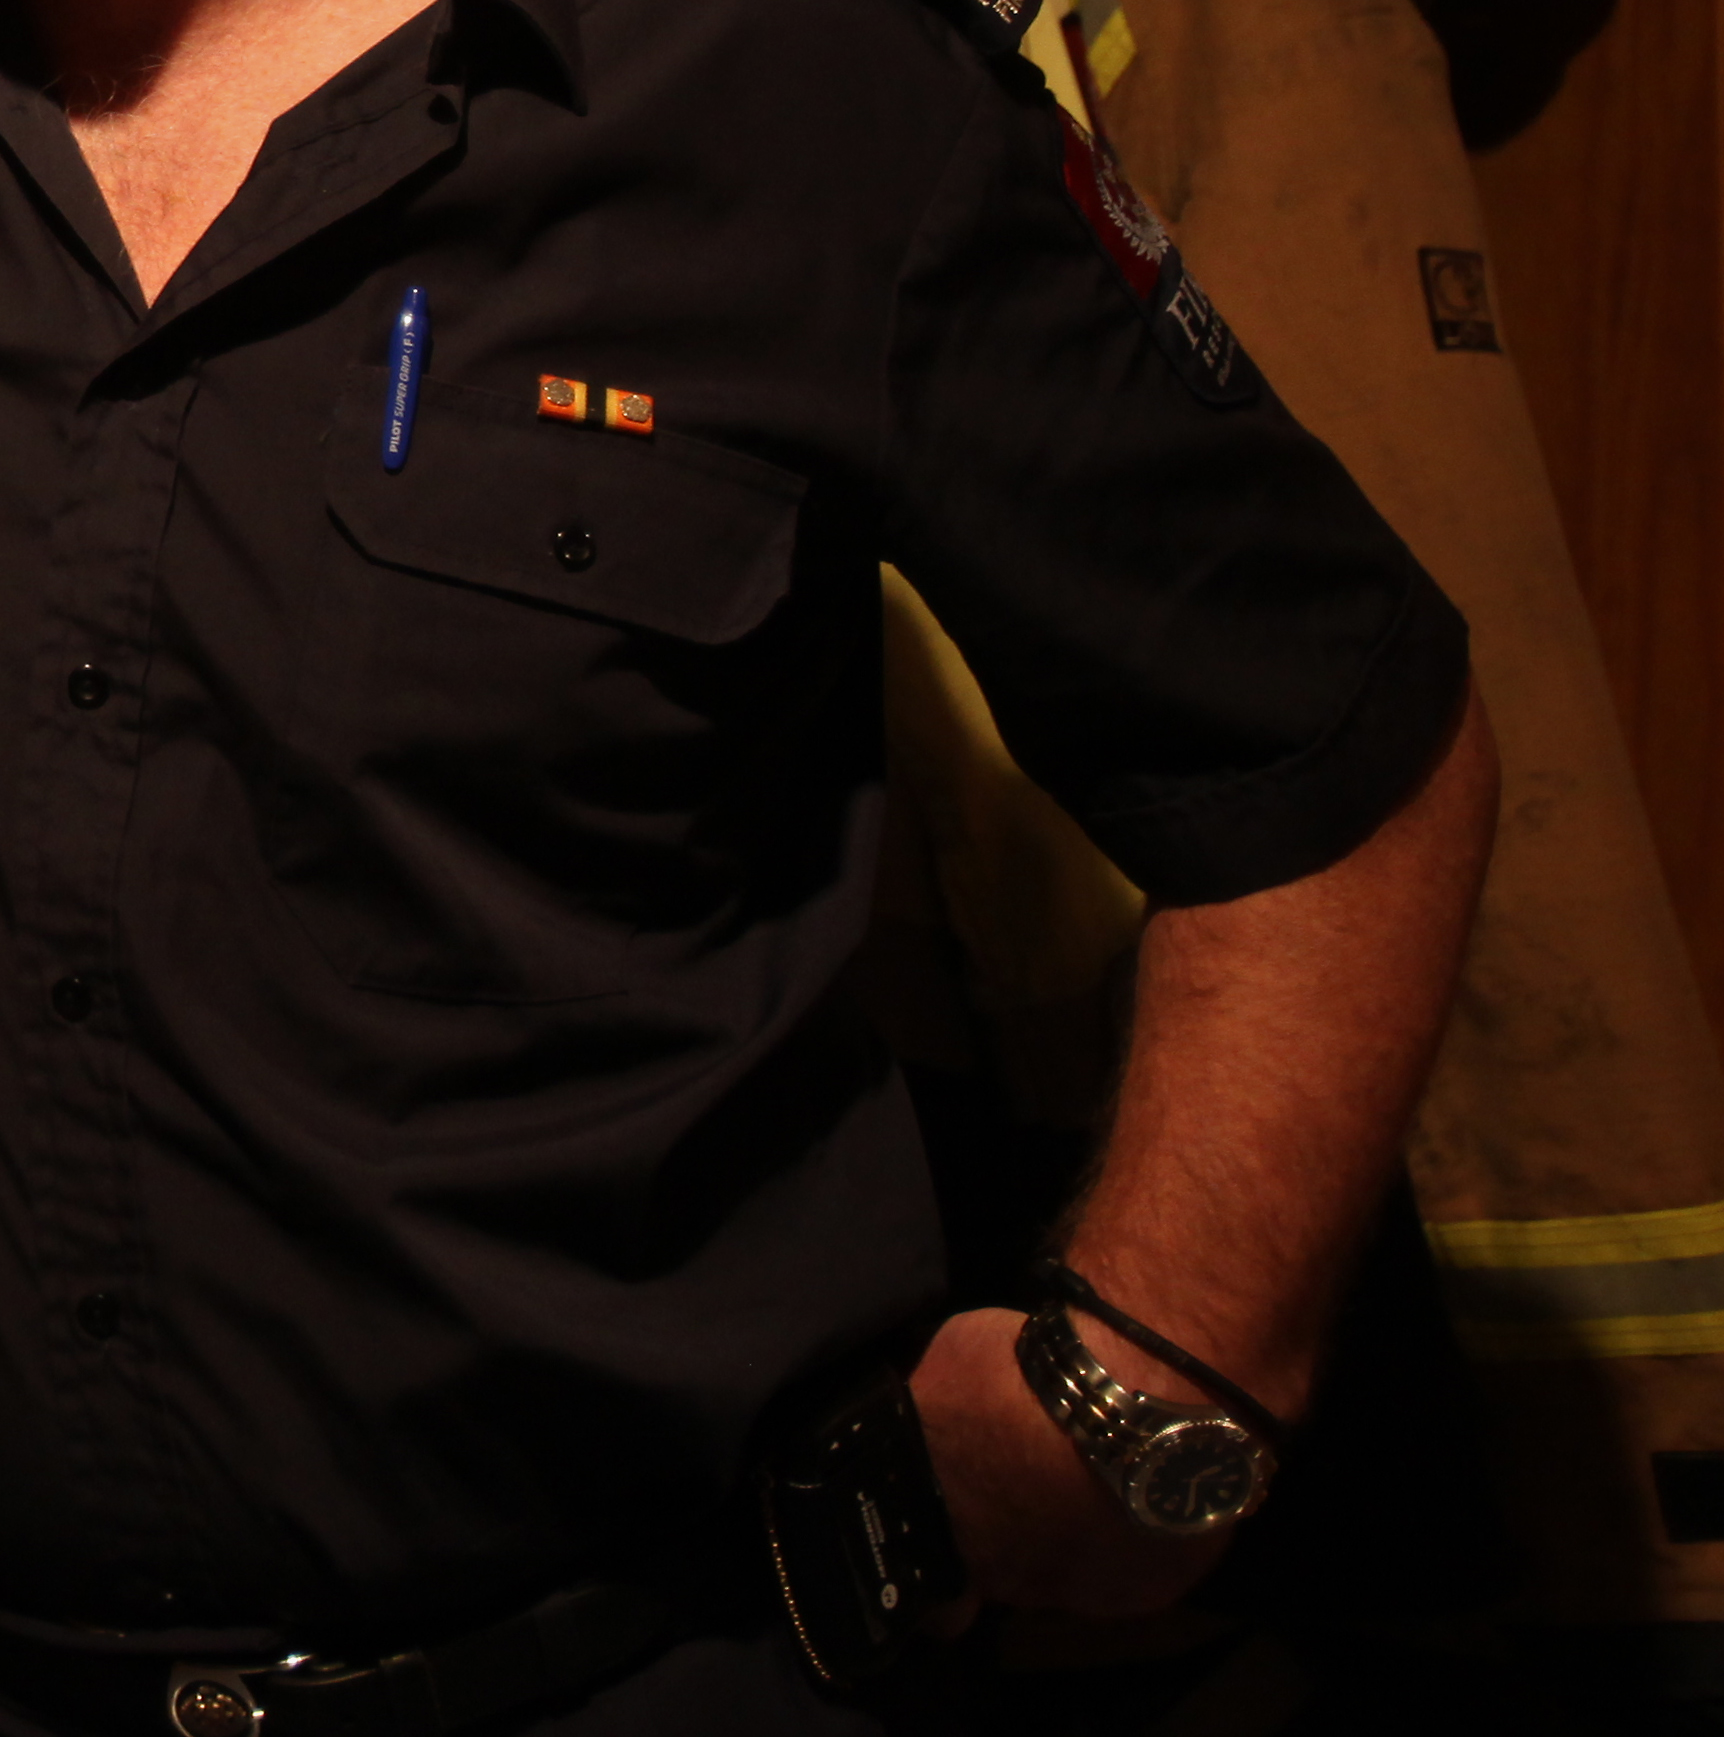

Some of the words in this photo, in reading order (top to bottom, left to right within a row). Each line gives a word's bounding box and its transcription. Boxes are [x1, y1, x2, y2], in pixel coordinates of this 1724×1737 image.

[1165, 276, 1210, 351] FI
[399, 355, 413, 382] GRIP
[394, 383, 408, 417] SUPER
[388, 420, 403, 453] PILOT
